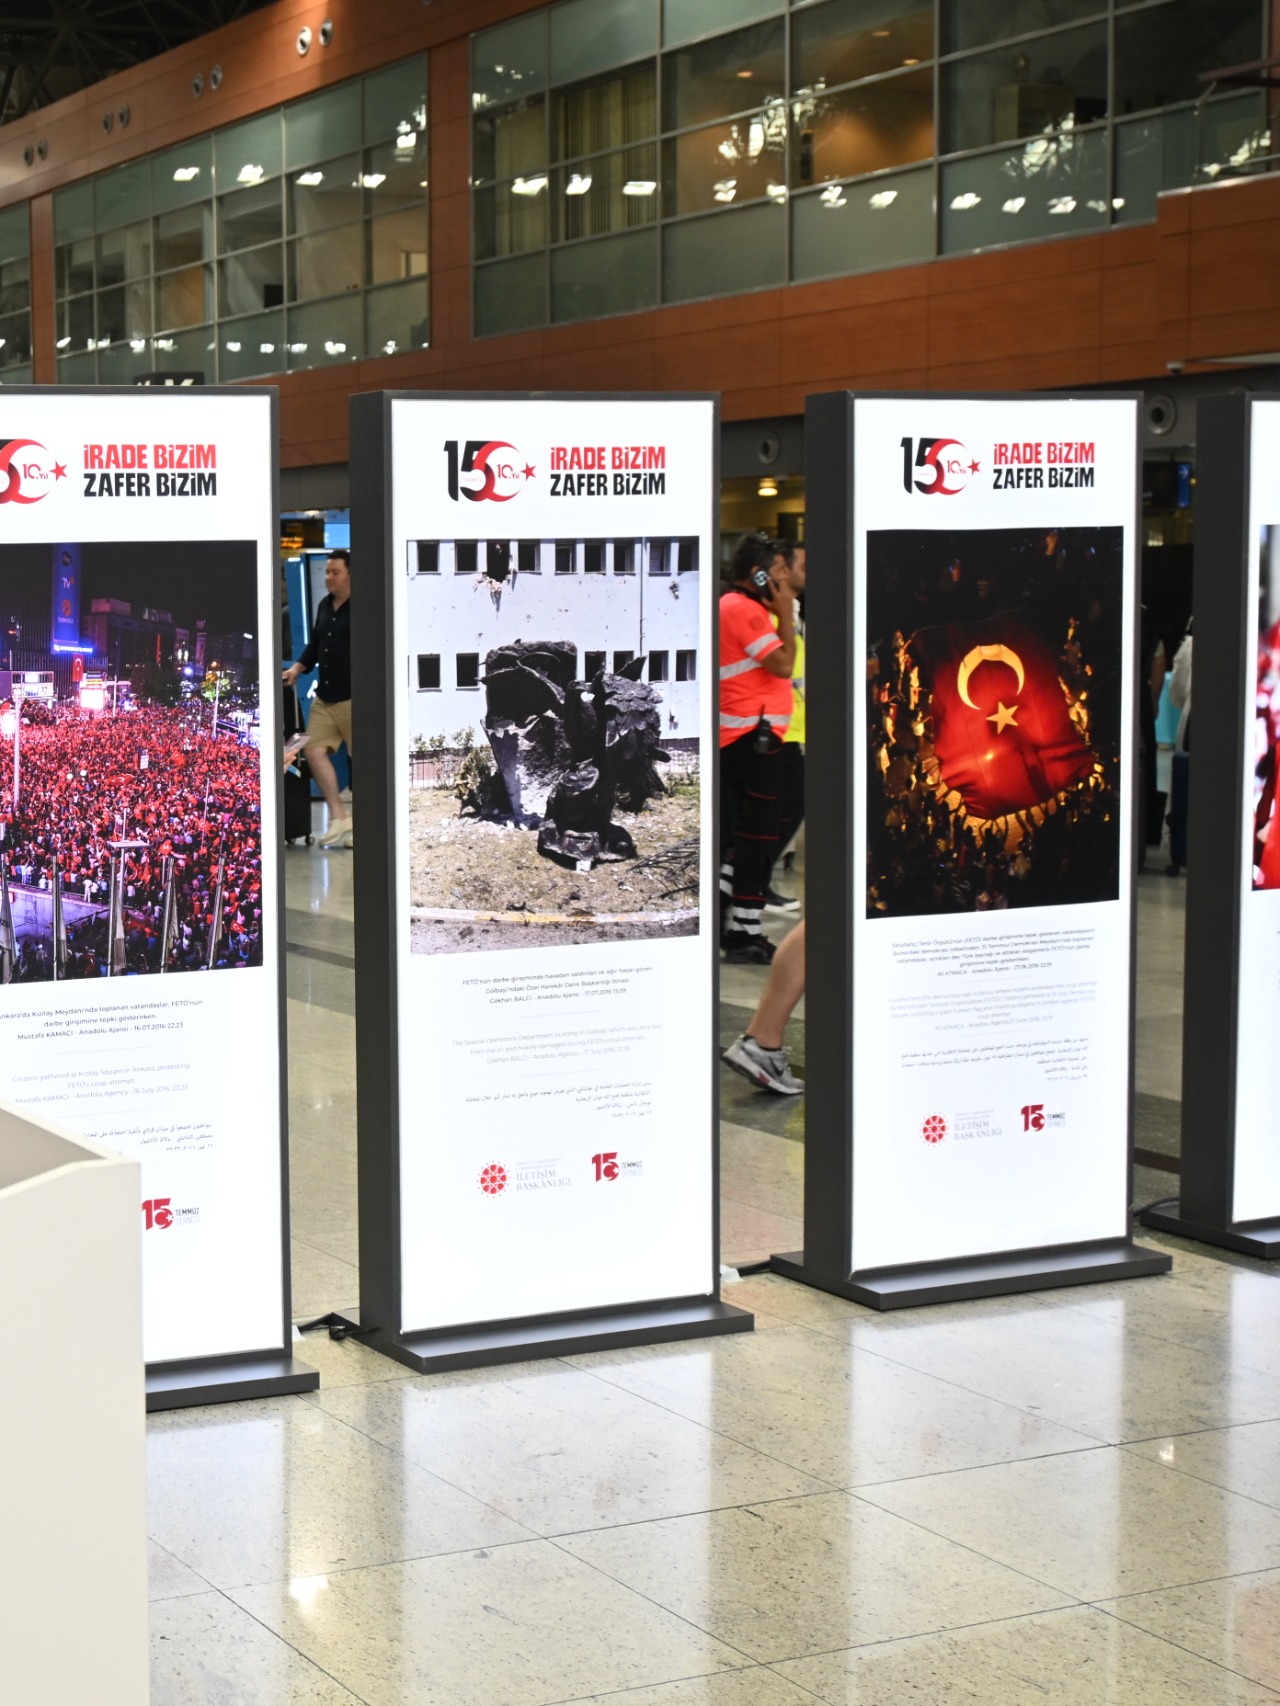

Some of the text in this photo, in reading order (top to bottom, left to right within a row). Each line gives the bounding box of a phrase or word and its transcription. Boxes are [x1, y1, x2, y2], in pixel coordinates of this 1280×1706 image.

[83, 473, 150, 497] ZAFER
[550, 473, 608, 496] ZAFER
[993, 467, 1043, 489] ZAFER
[32, 1010, 53, 1018] Kızılay
[55, 1007, 97, 1016] Meydanı'nda
[100, 1005, 128, 1013] toplanan
[130, 1001, 170, 1009] vatandaşlar,
[172, 999, 203, 1007] FETÖ'nün
[44, 1020, 63, 1028] darbe
[65, 1018, 98, 1027] girişimine
[100, 1015, 116, 1023] tepki
[17, 1032, 44, 1040] Mustafa
[79, 1027, 107, 1035] Anadolu
[108, 1026, 128, 1034] Ajansı
[12, 1075, 37, 1083] Citizens
[39, 1072, 69, 1081] gathered
[100, 1068, 123, 1076] Square
[158, 1063, 190, 1071] protesting
[91, 1080, 107, 1088] coup
[76, 1090, 102, 1098] Anadolu
[105, 1089, 128, 1097] Agency
[141, 1086, 154, 1094] July
[516, 1168, 556, 1181] İLETİŞİM
[516, 1177, 571, 1191] BAŞKANLIĞI
[175, 1207, 200, 1216] TEMMUZ
